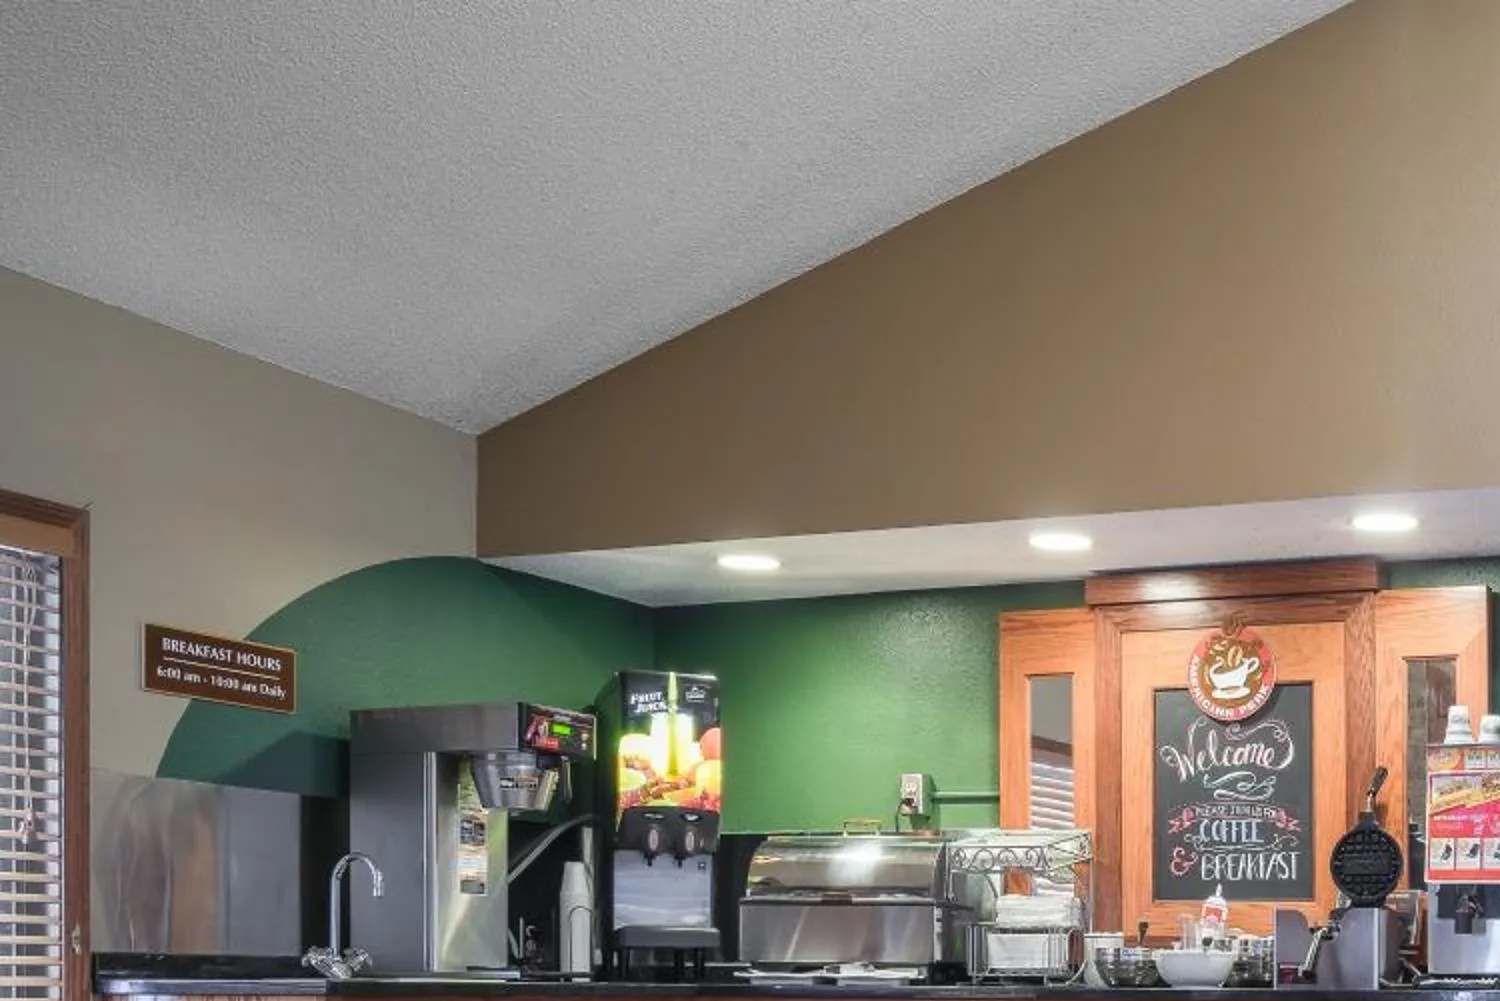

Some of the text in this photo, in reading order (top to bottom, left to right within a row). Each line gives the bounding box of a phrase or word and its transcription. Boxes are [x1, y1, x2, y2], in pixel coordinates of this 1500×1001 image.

[161, 637, 282, 671] BREAKFAST HOURS
[259, 683, 287, 699] Daily
[1160, 718, 1294, 783] Welcome
[1199, 818, 1265, 843] COFFEE
[1201, 850, 1302, 881] BREAKFAST
